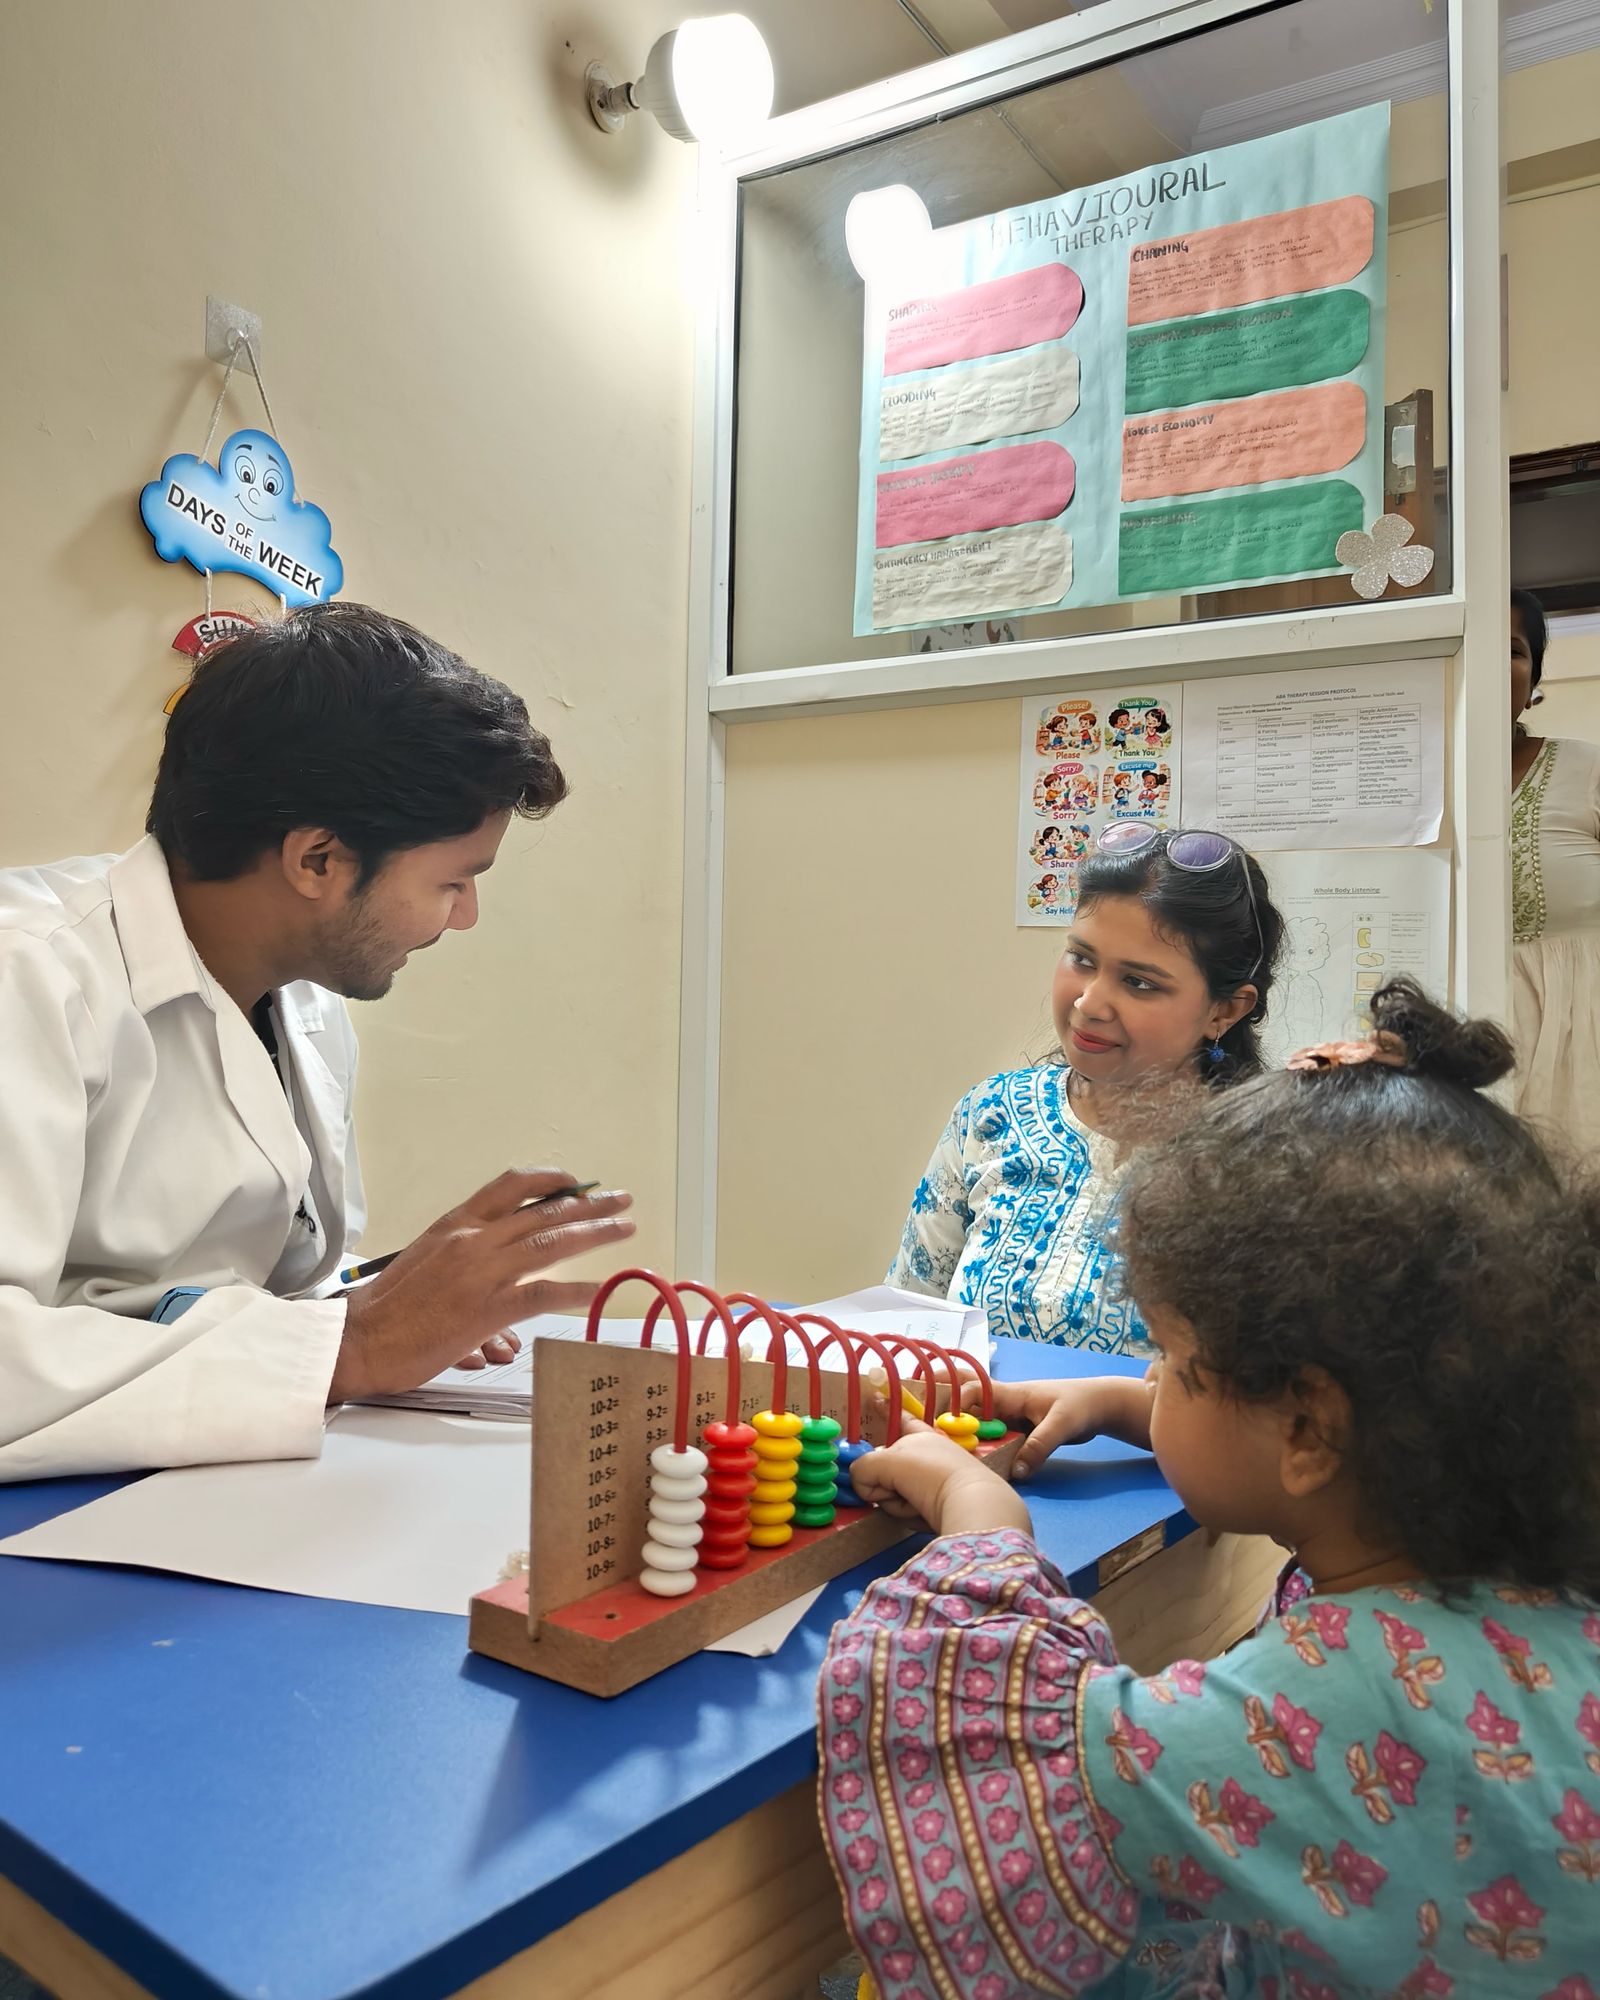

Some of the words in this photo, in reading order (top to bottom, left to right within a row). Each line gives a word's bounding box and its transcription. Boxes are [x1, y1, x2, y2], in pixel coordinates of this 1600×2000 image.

[1050, 210, 1154, 256] THERAPY
[883, 388, 937, 409] FLOODING
[167, 483, 227, 536] DAYS
[235, 522, 255, 539] OF
[227, 535, 254, 560] THE
[258, 540, 323, 597] WEEK
[1061, 701, 1089, 712] Please!
[1119, 700, 1139, 709] Thank
[1140, 698, 1156, 708] You!
[1055, 751, 1081, 761] Please
[1119, 749, 1140, 757] Thank
[1142, 749, 1156, 757] You
[1056, 764, 1081, 774] Sorry!
[1120, 763, 1140, 772] Excuse
[1053, 811, 1078, 821] Sorry
[1116, 809, 1143, 818] Excuse
[1144, 809, 1156, 817] Me
[1050, 860, 1075, 869] Share
[1334, 887, 1352, 895] Body
[1352, 886, 1381, 894] Listening
[1045, 907, 1058, 916] Say
[589, 1375, 620, 1392] 10-1=
[646, 1384, 669, 1400] 9-1=
[589, 1398, 620, 1416] 10-2=
[696, 1391, 717, 1406] 8-1=
[741, 1397, 760, 1411] 7-1=
[646, 1405, 669, 1422] 9-2=
[695, 1411, 716, 1427] 8-2=
[589, 1421, 619, 1439] 10-3=
[646, 1427, 669, 1444] 9-3=
[588, 1443, 619, 1462] 10-4=
[588, 1466, 618, 1486] 10-5=
[587, 1489, 617, 1509] 10-6=
[586, 1512, 617, 1533] 10-7=
[586, 1536, 616, 1556] 10-8=
[586, 1559, 616, 1581] 10-9=
